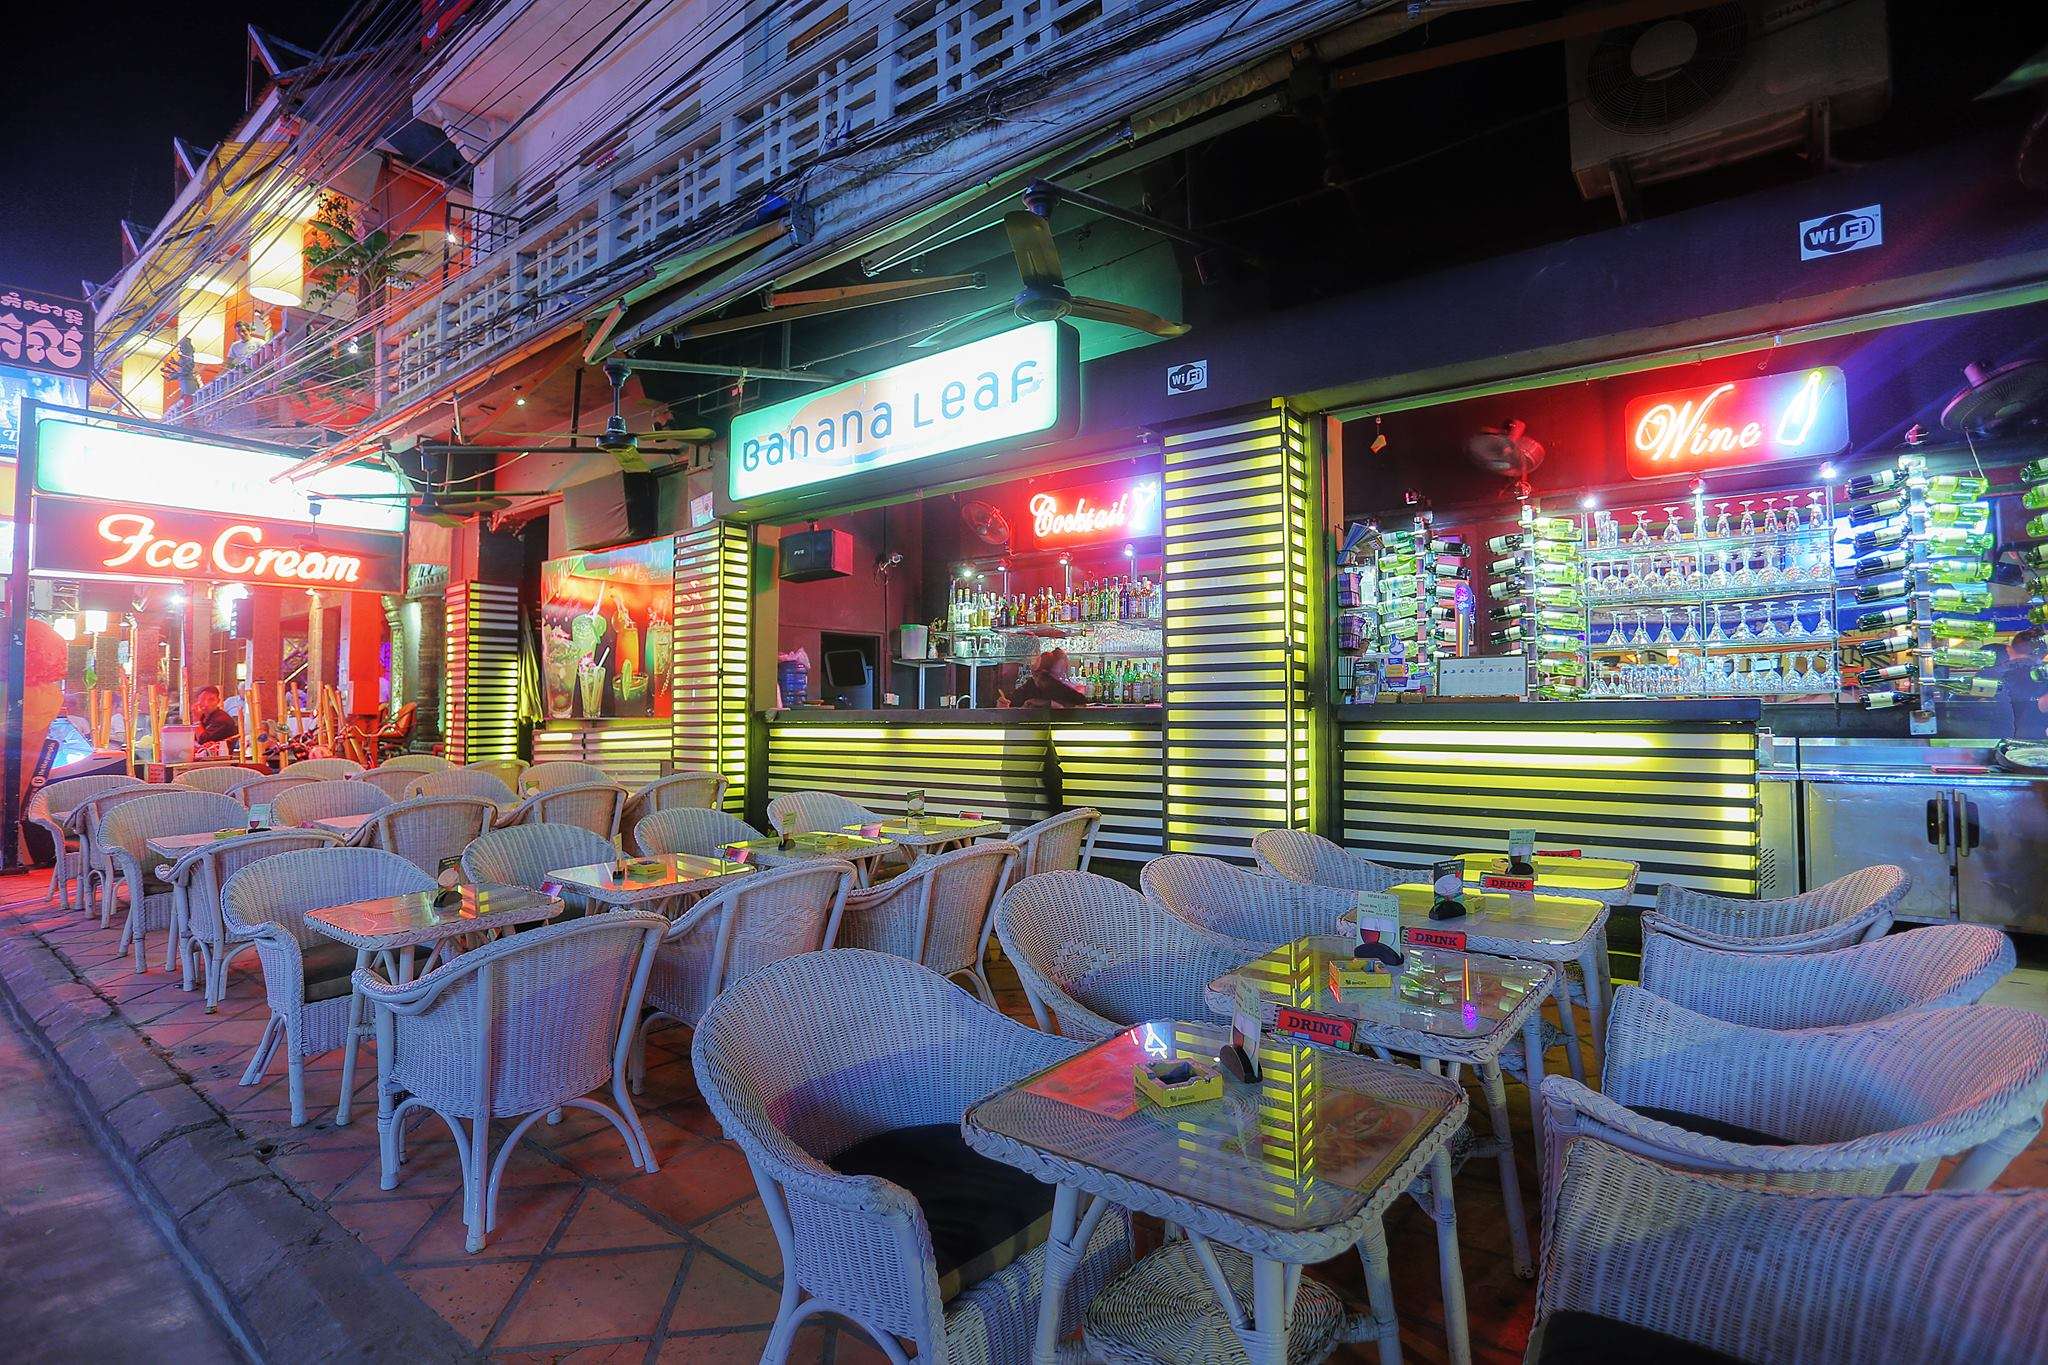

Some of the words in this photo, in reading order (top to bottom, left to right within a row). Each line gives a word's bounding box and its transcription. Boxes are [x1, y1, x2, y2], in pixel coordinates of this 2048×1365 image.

[743, 402, 893, 472] Banana
[1635, 383, 1763, 461] Wine
[1029, 491, 1129, 538] Cocktail
[98, 513, 203, 568] Ice
[211, 525, 361, 584] Cream
[1491, 880, 1528, 889] DRINK
[1414, 932, 1459, 946] DRINK
[1288, 1016, 1344, 1037] DRINK
